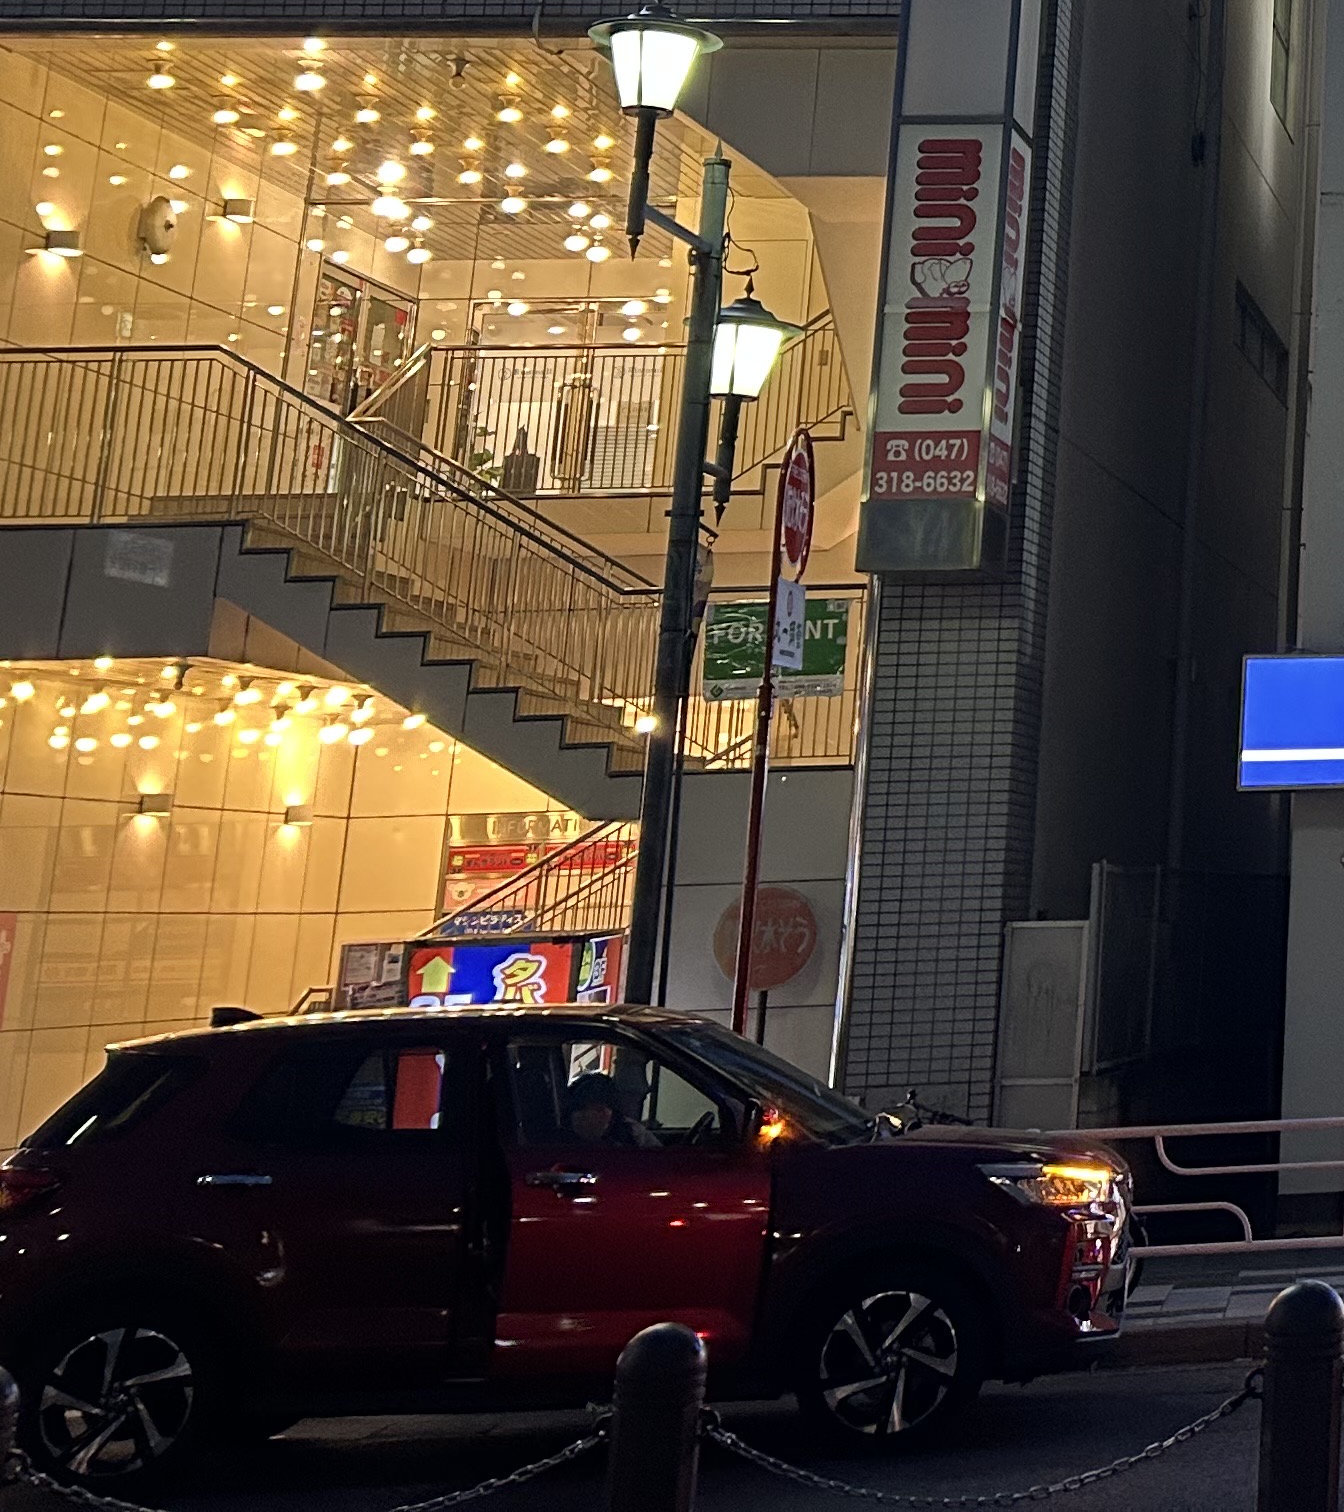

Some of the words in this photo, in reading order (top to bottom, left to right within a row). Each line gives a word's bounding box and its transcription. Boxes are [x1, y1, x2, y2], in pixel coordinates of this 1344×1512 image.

[909, 138, 984, 257] mini
[914, 436, 970, 463] (047)
[874, 468, 976, 495] 318-6632
[711, 621, 765, 645] FOR
